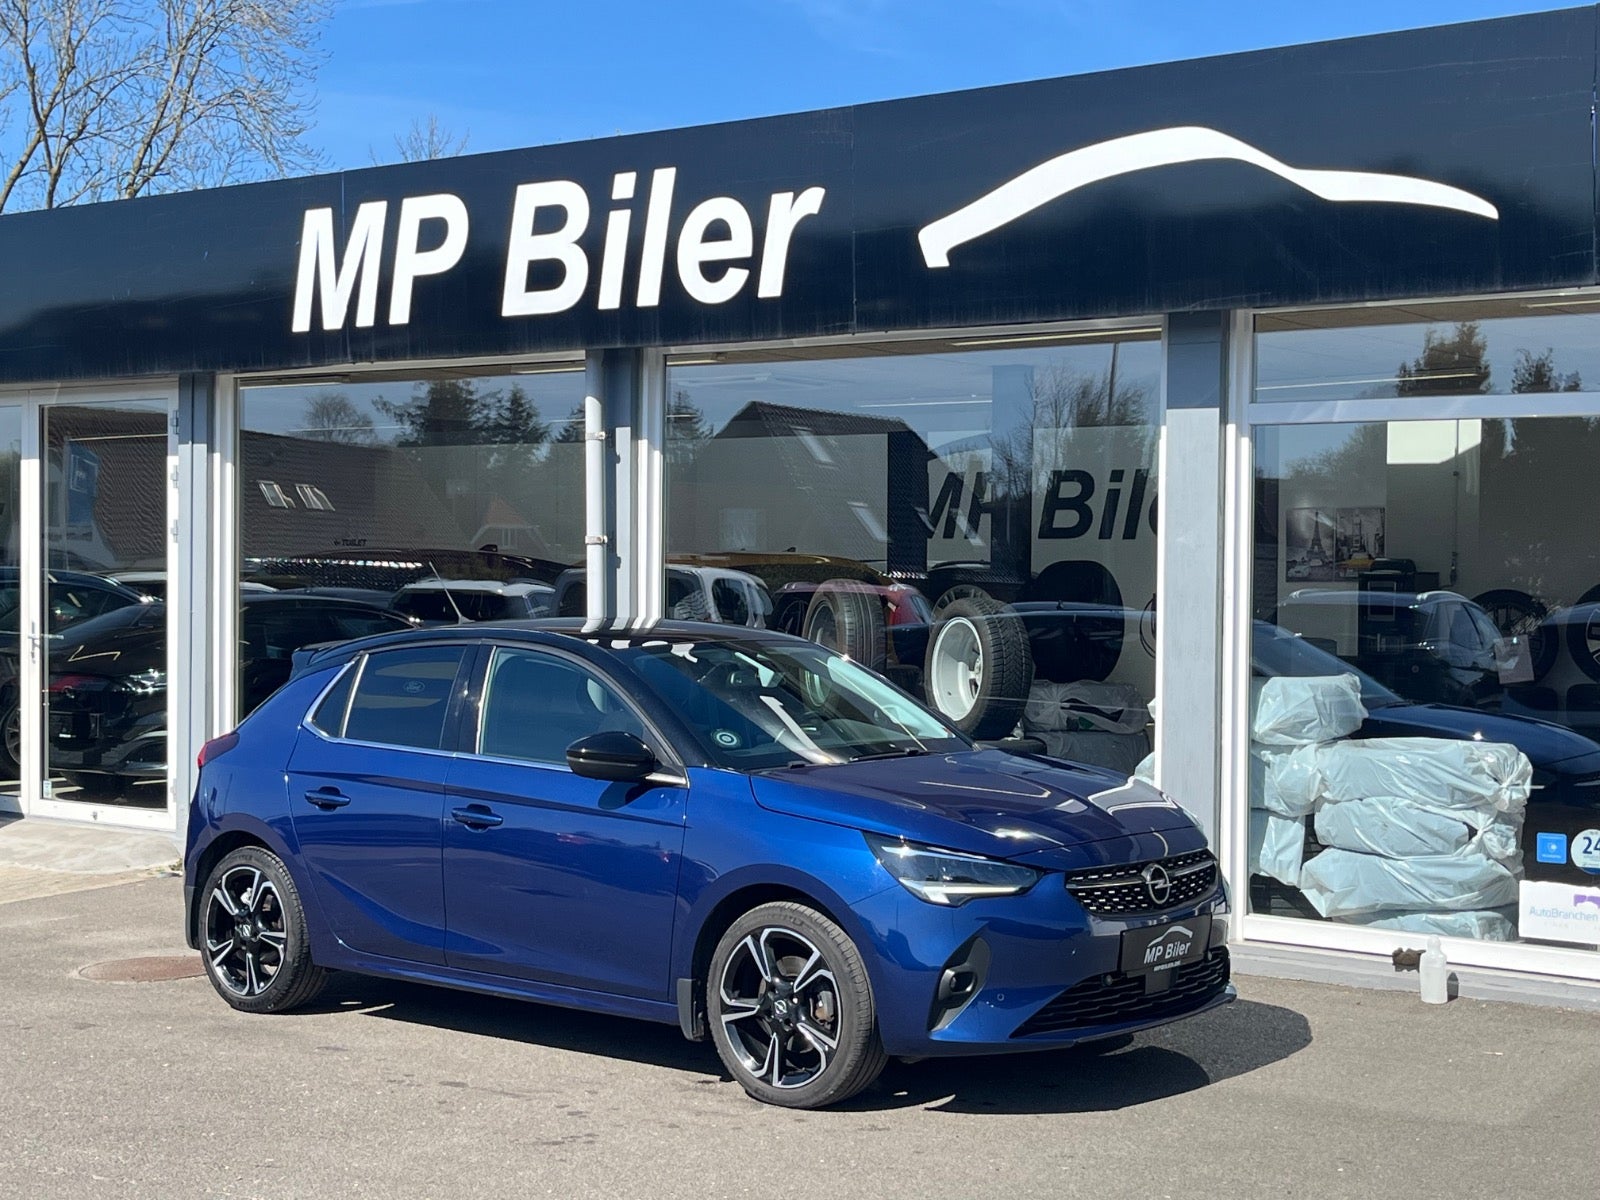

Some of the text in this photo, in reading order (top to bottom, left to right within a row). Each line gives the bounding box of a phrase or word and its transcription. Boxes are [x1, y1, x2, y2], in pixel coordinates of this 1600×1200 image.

[291, 166, 826, 333] MP Biler
[1037, 469, 1159, 540] Bil
[1143, 940, 1191, 964] MP Biler
